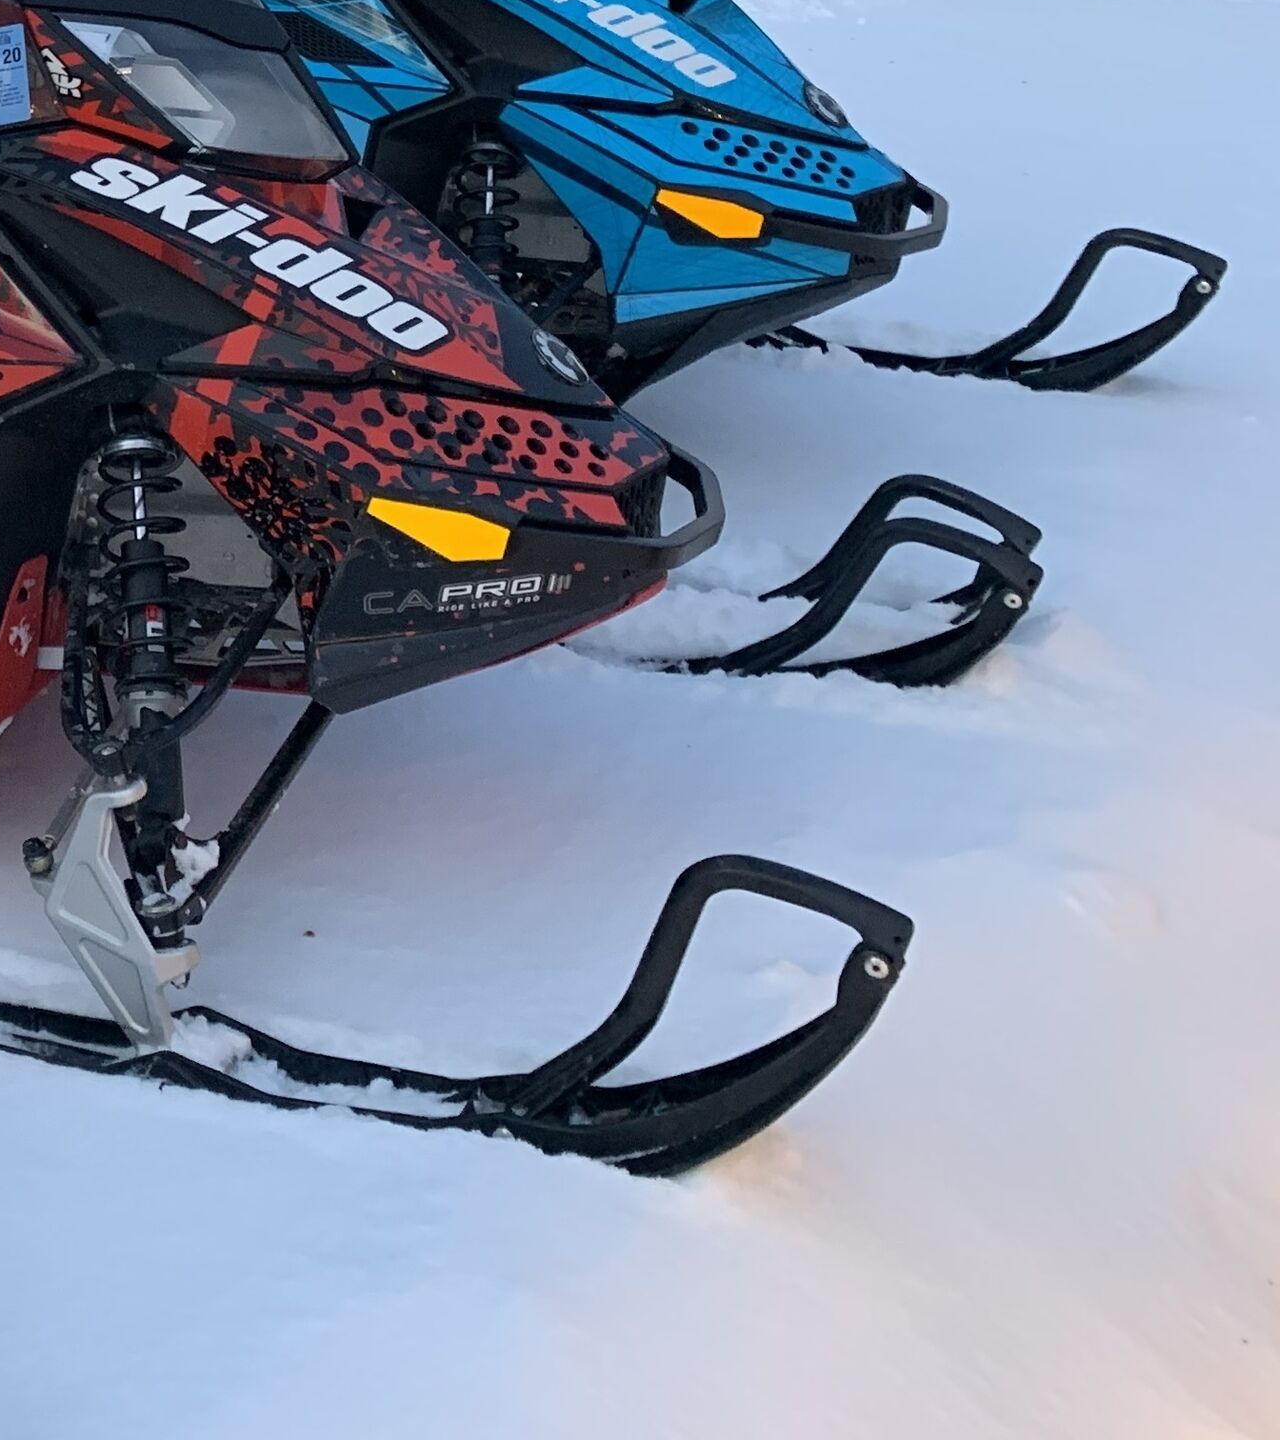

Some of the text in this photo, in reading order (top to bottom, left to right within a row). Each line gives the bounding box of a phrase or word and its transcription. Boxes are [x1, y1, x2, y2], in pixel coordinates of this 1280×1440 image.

[2, 46, 23, 66] 20
[69, 157, 450, 351] ski-doo
[437, 594, 541, 613] RIDE LIKE A PRO
